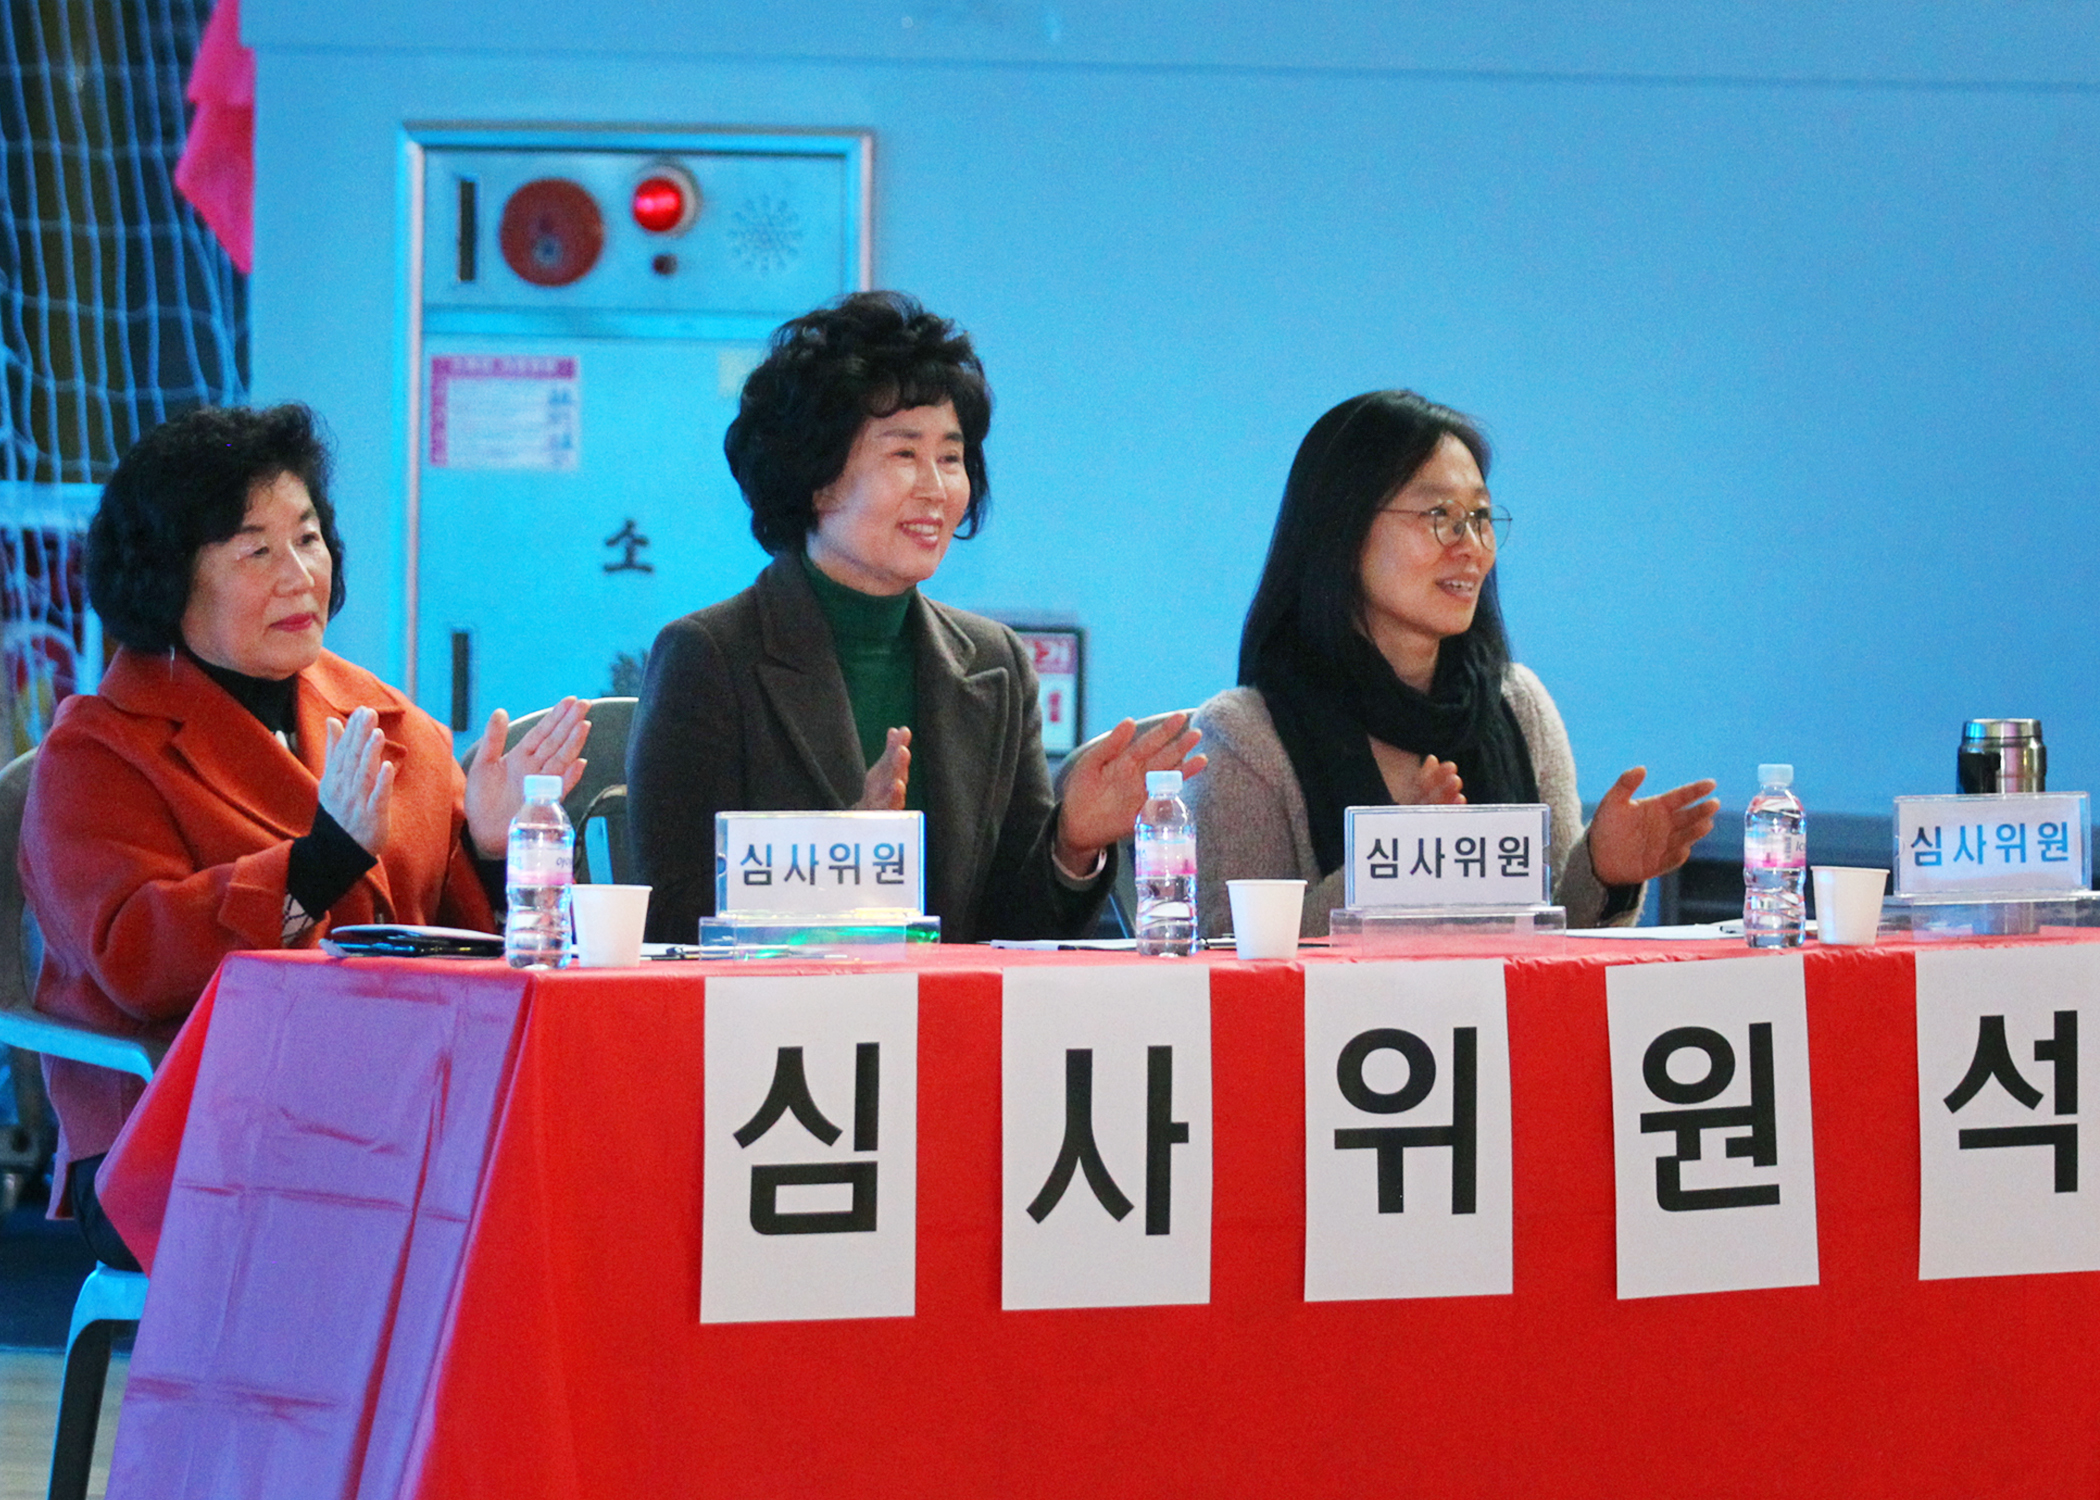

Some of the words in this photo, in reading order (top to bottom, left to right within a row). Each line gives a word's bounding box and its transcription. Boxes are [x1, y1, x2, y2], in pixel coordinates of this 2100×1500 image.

[740, 843, 905, 886] 심사위원
[1366, 836, 1530, 879] 심사위원
[1910, 821, 2070, 867] 심사위원
[733, 1009, 2078, 1236] 심사위원석
